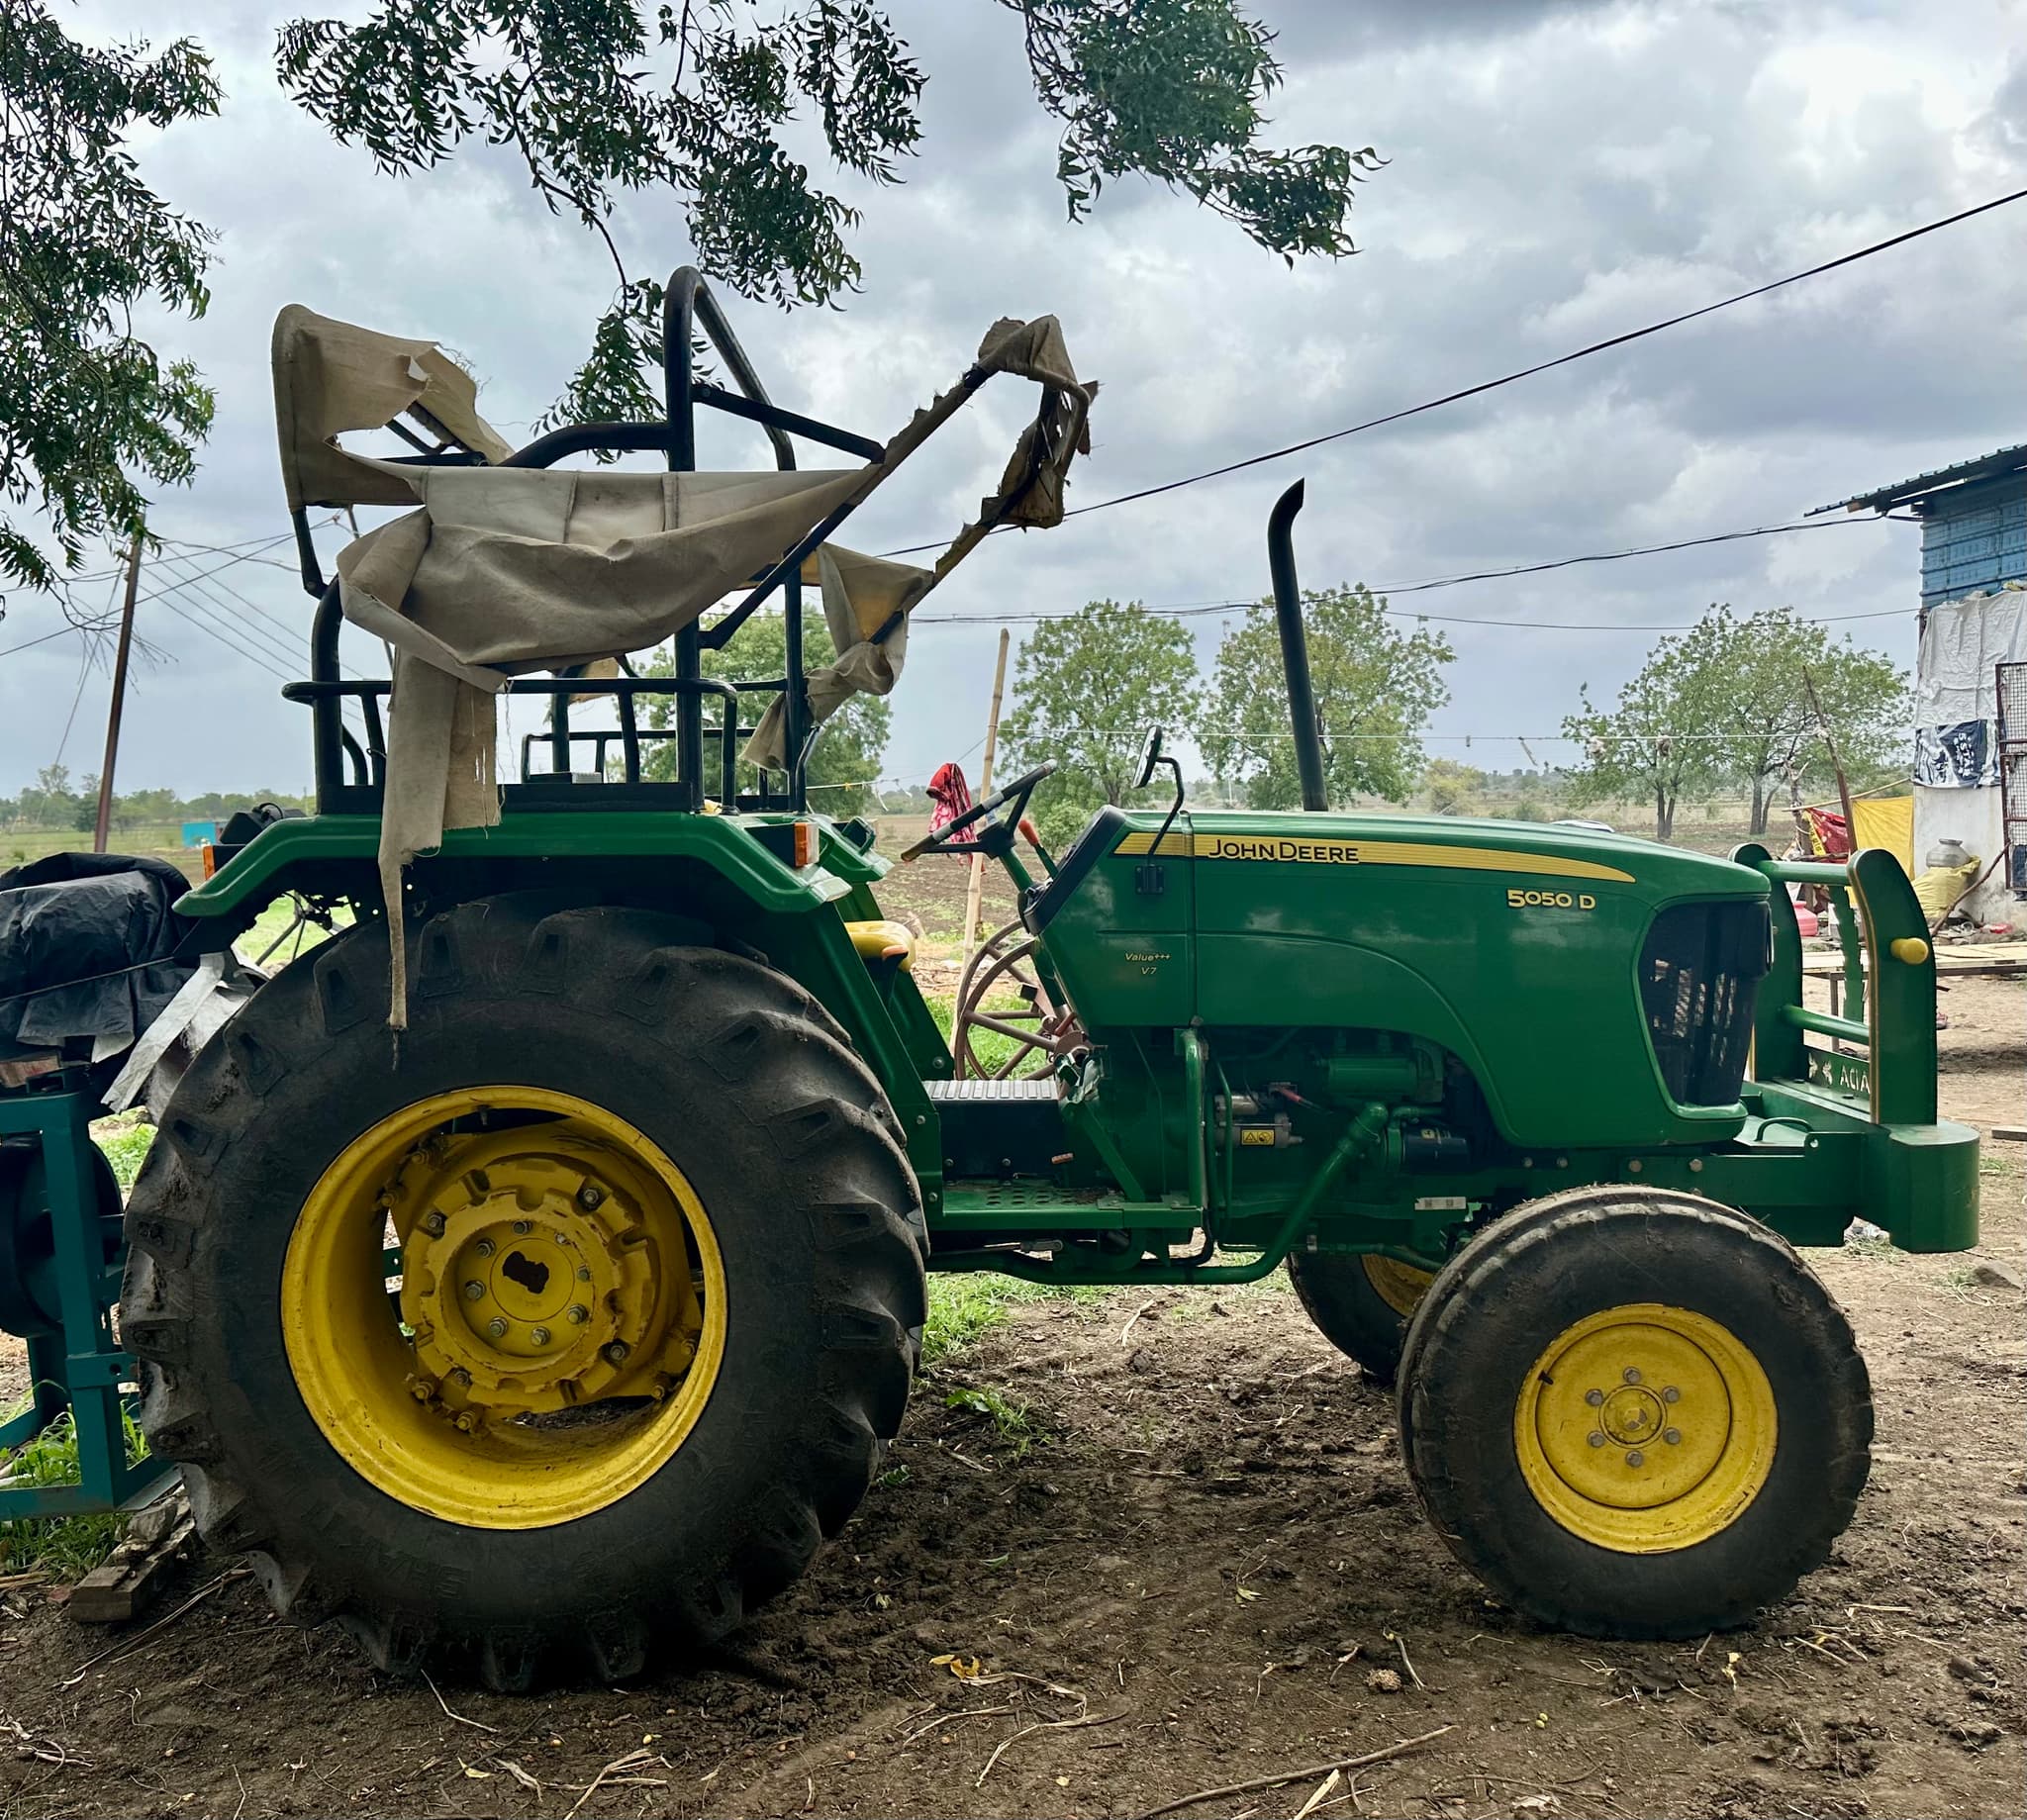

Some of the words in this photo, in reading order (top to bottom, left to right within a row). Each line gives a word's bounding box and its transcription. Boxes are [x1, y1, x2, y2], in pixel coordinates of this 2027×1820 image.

[1208, 838, 1275, 859] JOHN
[1279, 841, 1360, 862] DEERE
[1507, 889, 1573, 909] 5050
[1579, 894, 1596, 910] D
[1141, 966, 1157, 975] V7
